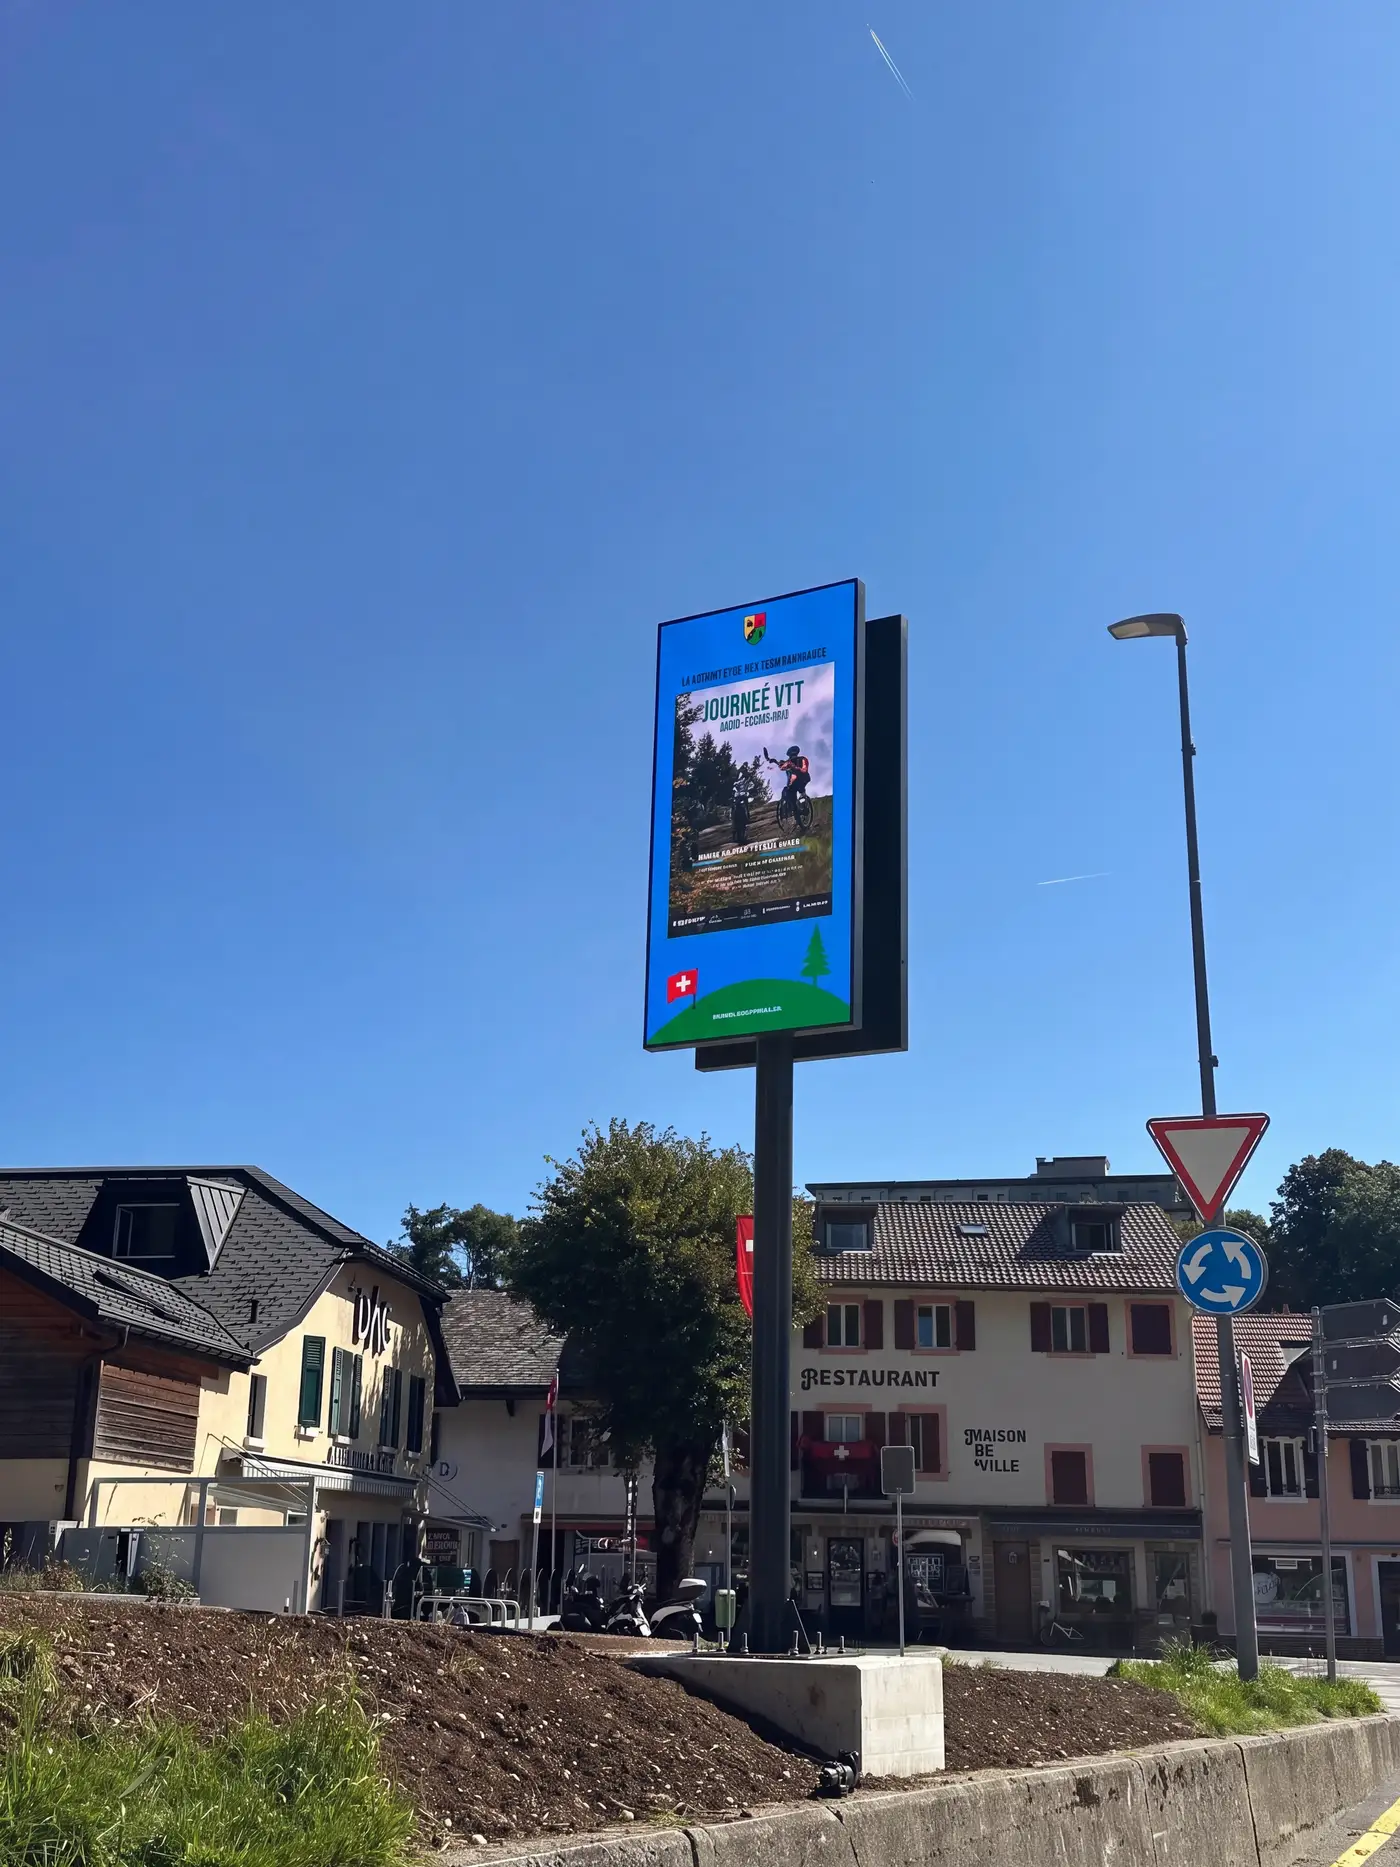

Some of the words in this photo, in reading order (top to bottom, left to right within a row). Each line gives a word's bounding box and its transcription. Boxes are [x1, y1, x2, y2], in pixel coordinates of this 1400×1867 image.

[702, 682, 770, 722] JOURNEÉ
[775, 680, 805, 709] VTT
[801, 1368, 940, 1391] RESTAURANT
[964, 1428, 1026, 1446] MAISON
